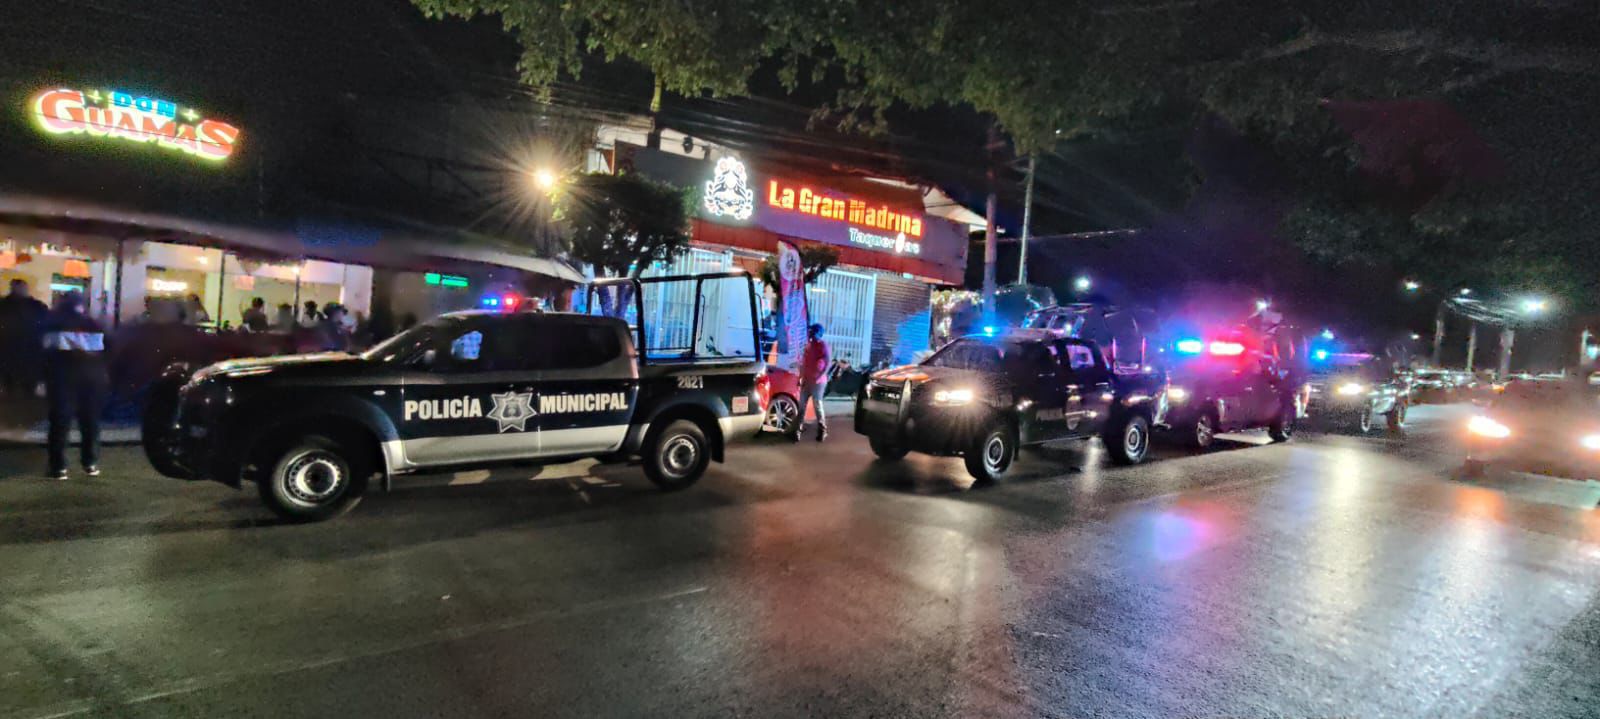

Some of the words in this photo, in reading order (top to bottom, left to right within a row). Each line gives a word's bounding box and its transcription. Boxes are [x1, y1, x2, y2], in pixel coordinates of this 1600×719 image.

[112, 91, 176, 118] DON
[37, 90, 239, 158] GUAMAS
[768, 180, 795, 209] La
[799, 187, 845, 219] Gran
[848, 199, 921, 236] Madrina
[677, 375, 704, 389] 2021
[404, 395, 483, 421] POLICÍA
[540, 391, 628, 414] MUNICIPAL
